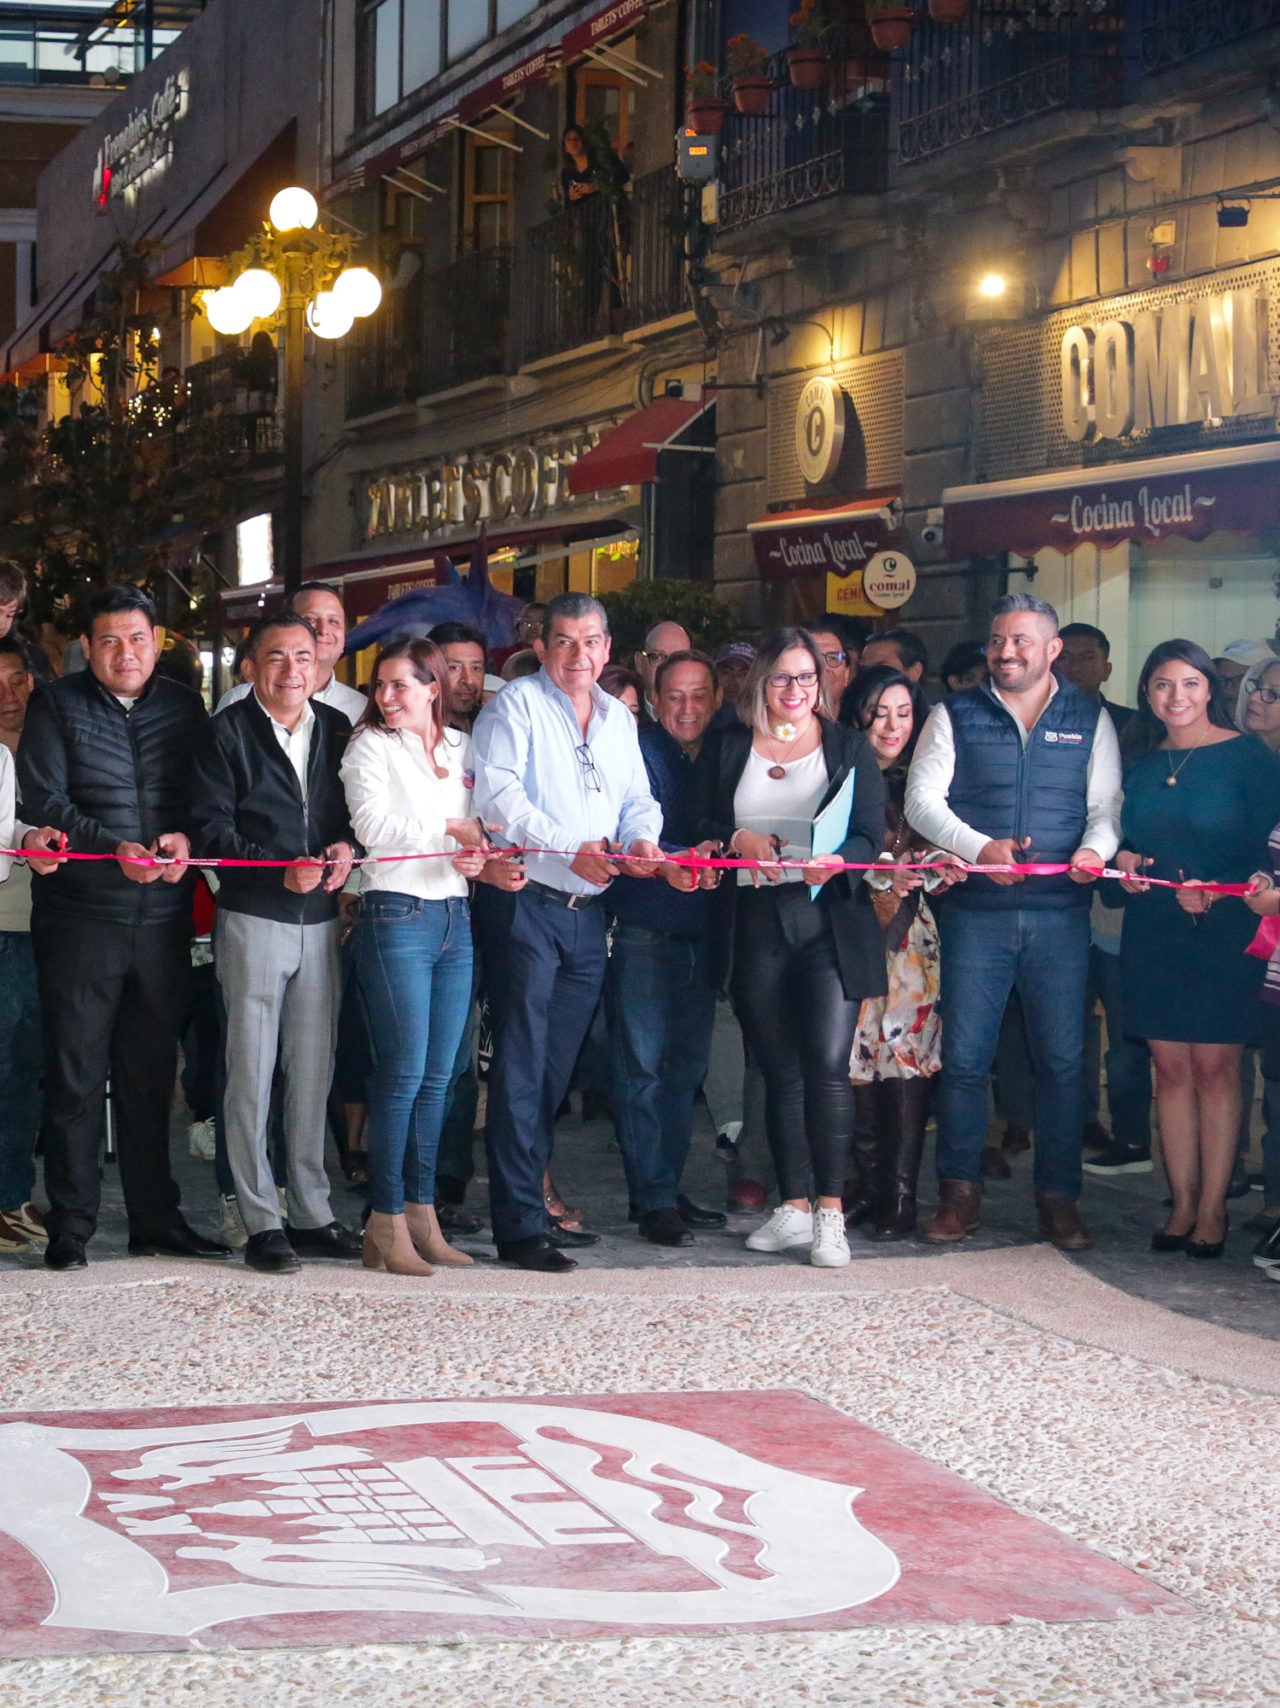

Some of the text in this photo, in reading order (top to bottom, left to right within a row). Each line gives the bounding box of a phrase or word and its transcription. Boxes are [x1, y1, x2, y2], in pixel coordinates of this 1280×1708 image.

[1060, 289, 1275, 442] COMAL
[1071, 484, 1194, 537] Cocina Local
[779, 531, 867, 571] Cocina Local
[870, 579, 910, 592] comal
